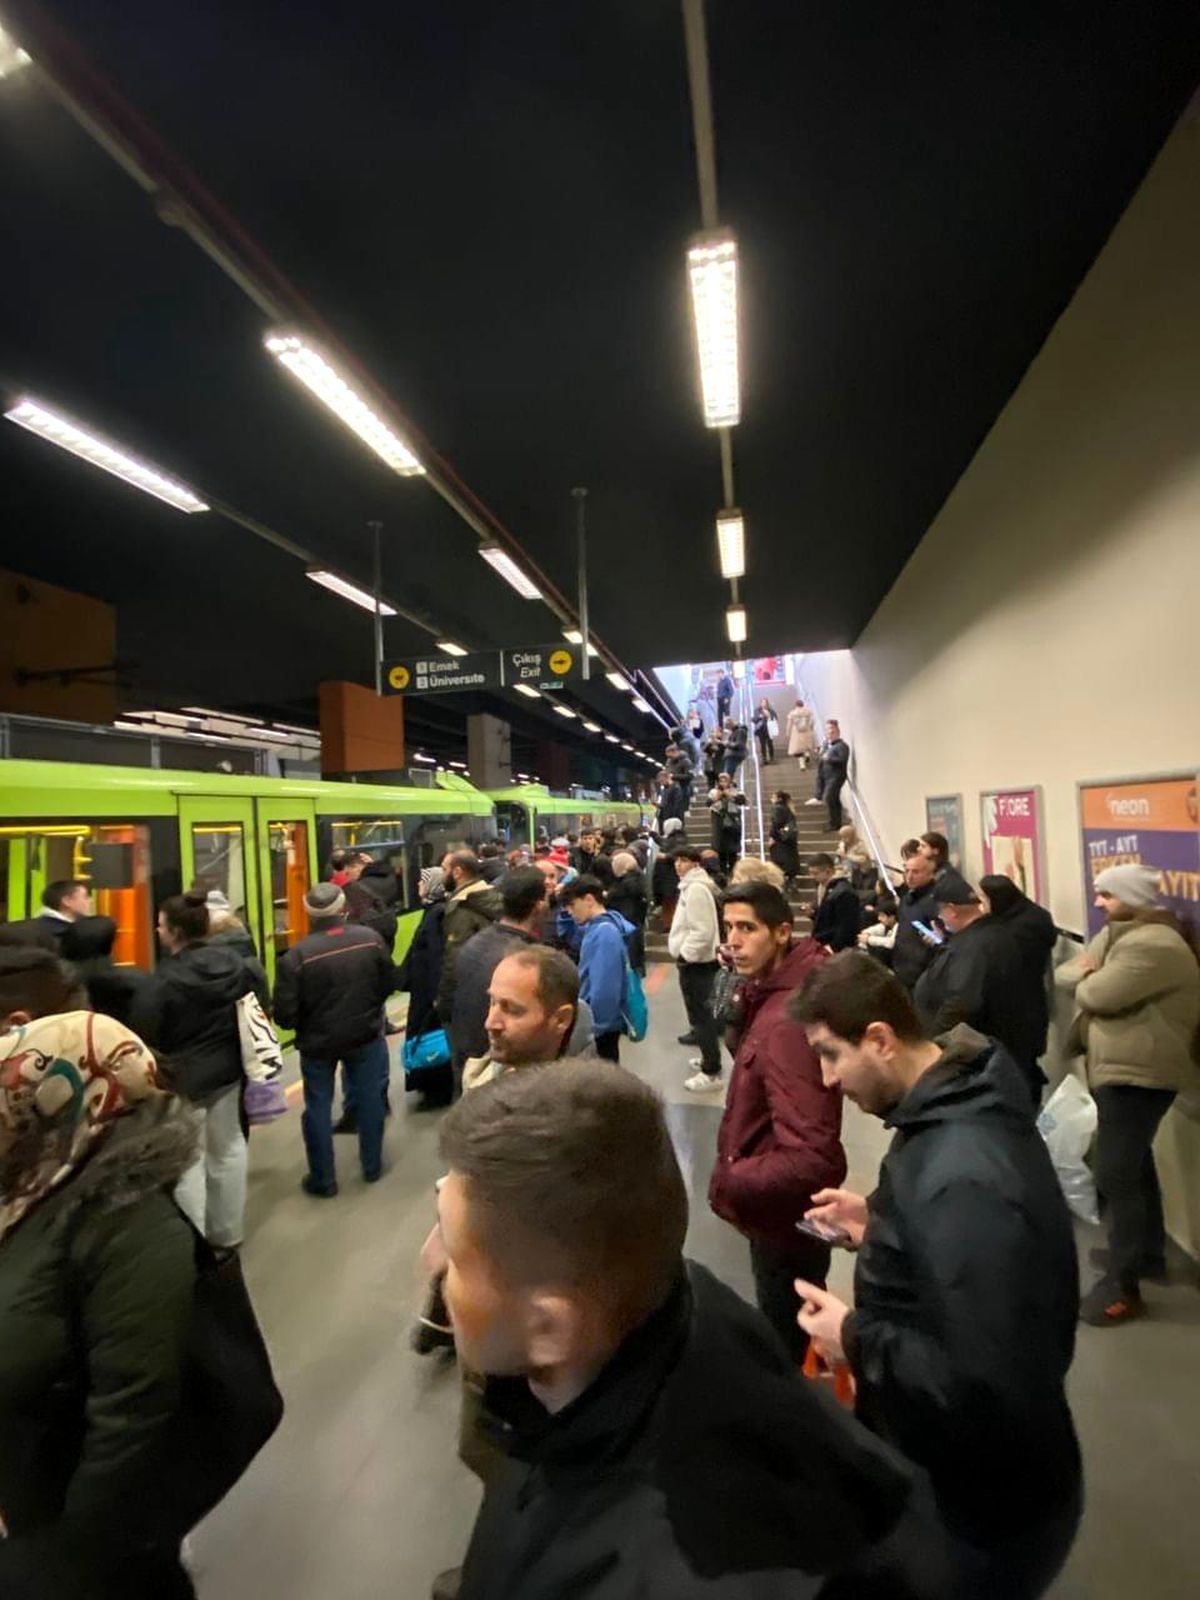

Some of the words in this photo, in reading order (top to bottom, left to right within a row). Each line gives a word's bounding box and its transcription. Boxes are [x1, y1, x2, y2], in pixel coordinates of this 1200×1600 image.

[429, 660, 460, 673] Emek
[512, 653, 541, 667] Çıkış
[520, 667, 541, 678] Exit
[1110, 798, 1150, 816] neon
